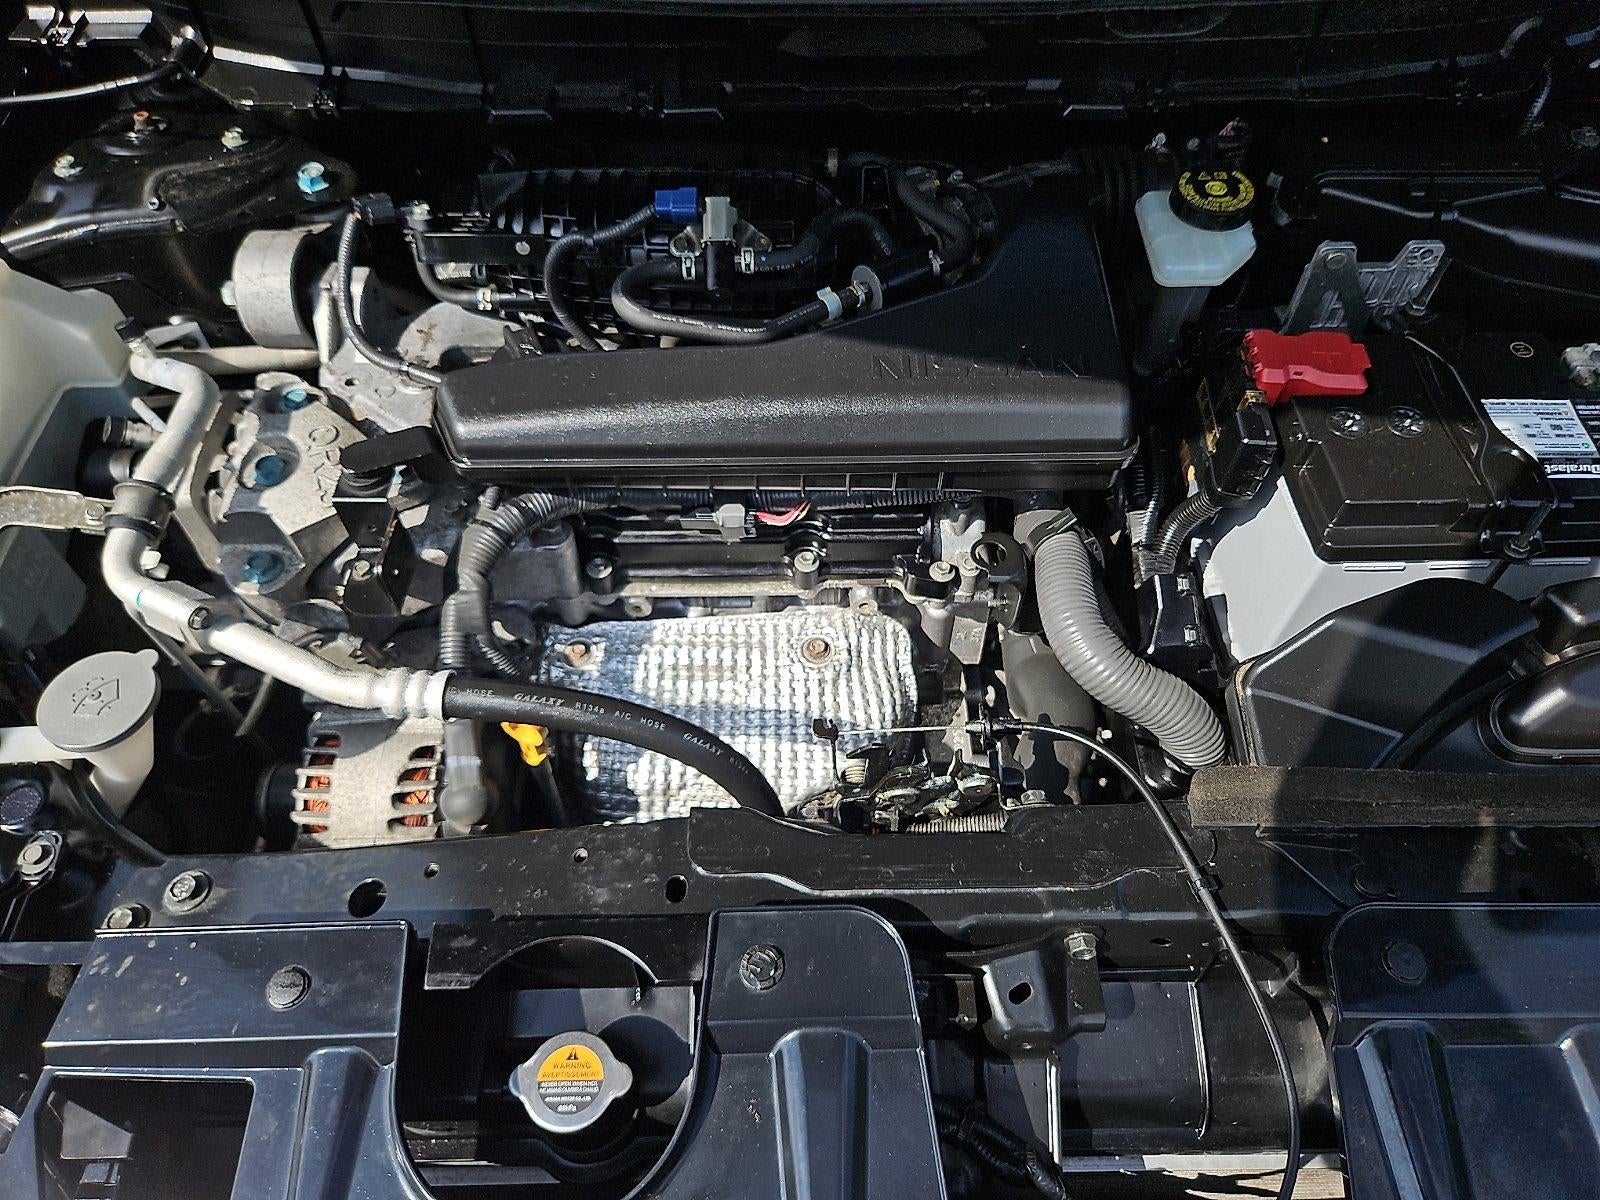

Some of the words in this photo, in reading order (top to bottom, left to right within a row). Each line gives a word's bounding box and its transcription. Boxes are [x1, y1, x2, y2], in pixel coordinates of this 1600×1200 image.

[871, 354, 1092, 379] NISSAN
[1544, 464, 1600, 474] Duralast
[466, 688, 494, 697] HOSE
[514, 692, 565, 706] GALAXY
[575, 702, 605, 714] R134a
[614, 711, 633, 720] A/C
[640, 717, 666, 731] HOSE
[683, 733, 724, 756] GALAXY
